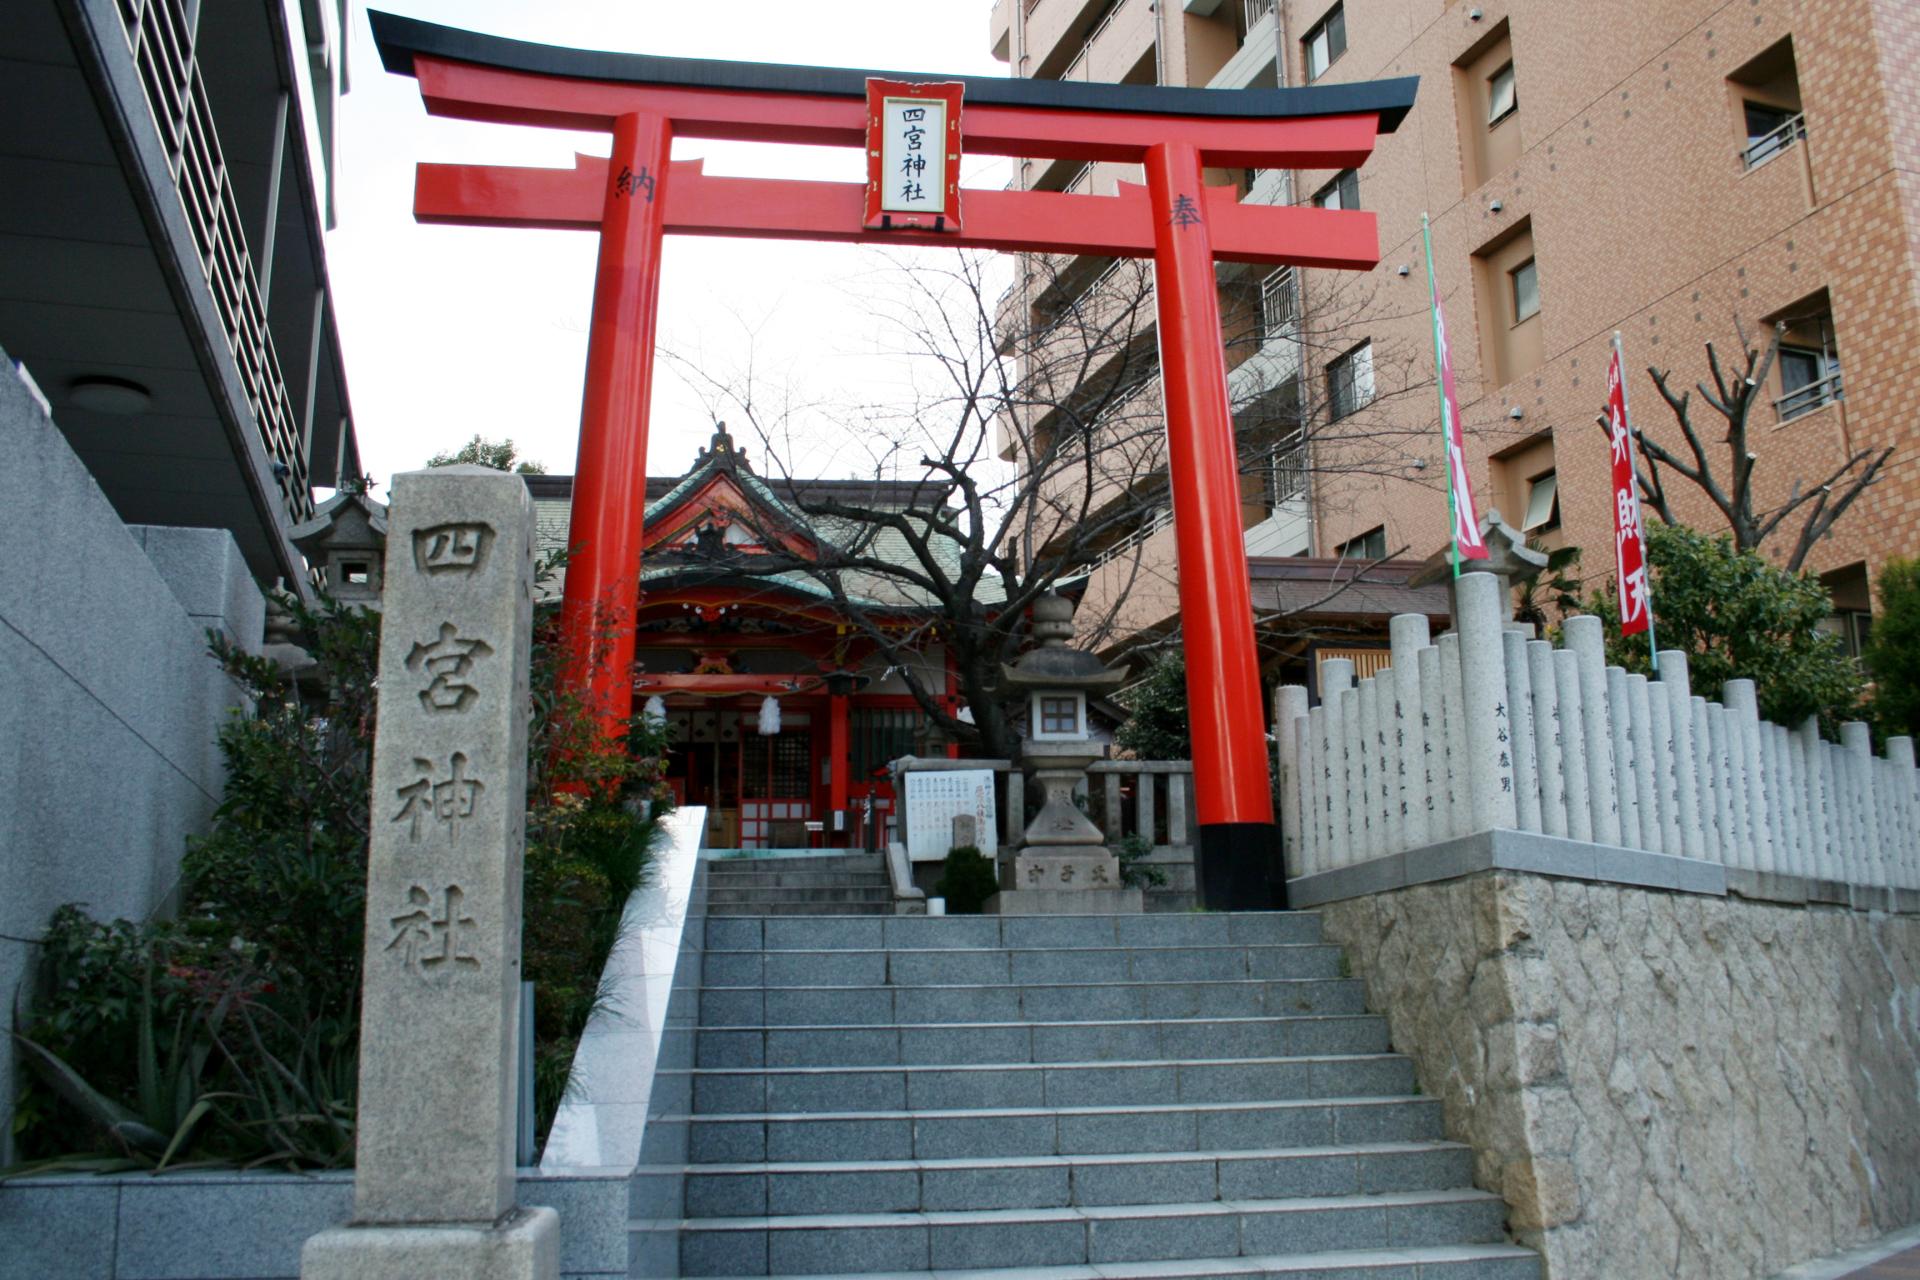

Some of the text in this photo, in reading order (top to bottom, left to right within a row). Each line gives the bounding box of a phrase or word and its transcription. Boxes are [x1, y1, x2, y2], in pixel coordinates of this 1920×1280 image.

[615, 165, 656, 203] 納
[900, 107, 926, 202] 四宮神社
[1168, 194, 1202, 231] 奉
[384, 521, 497, 971] 四宮神社
